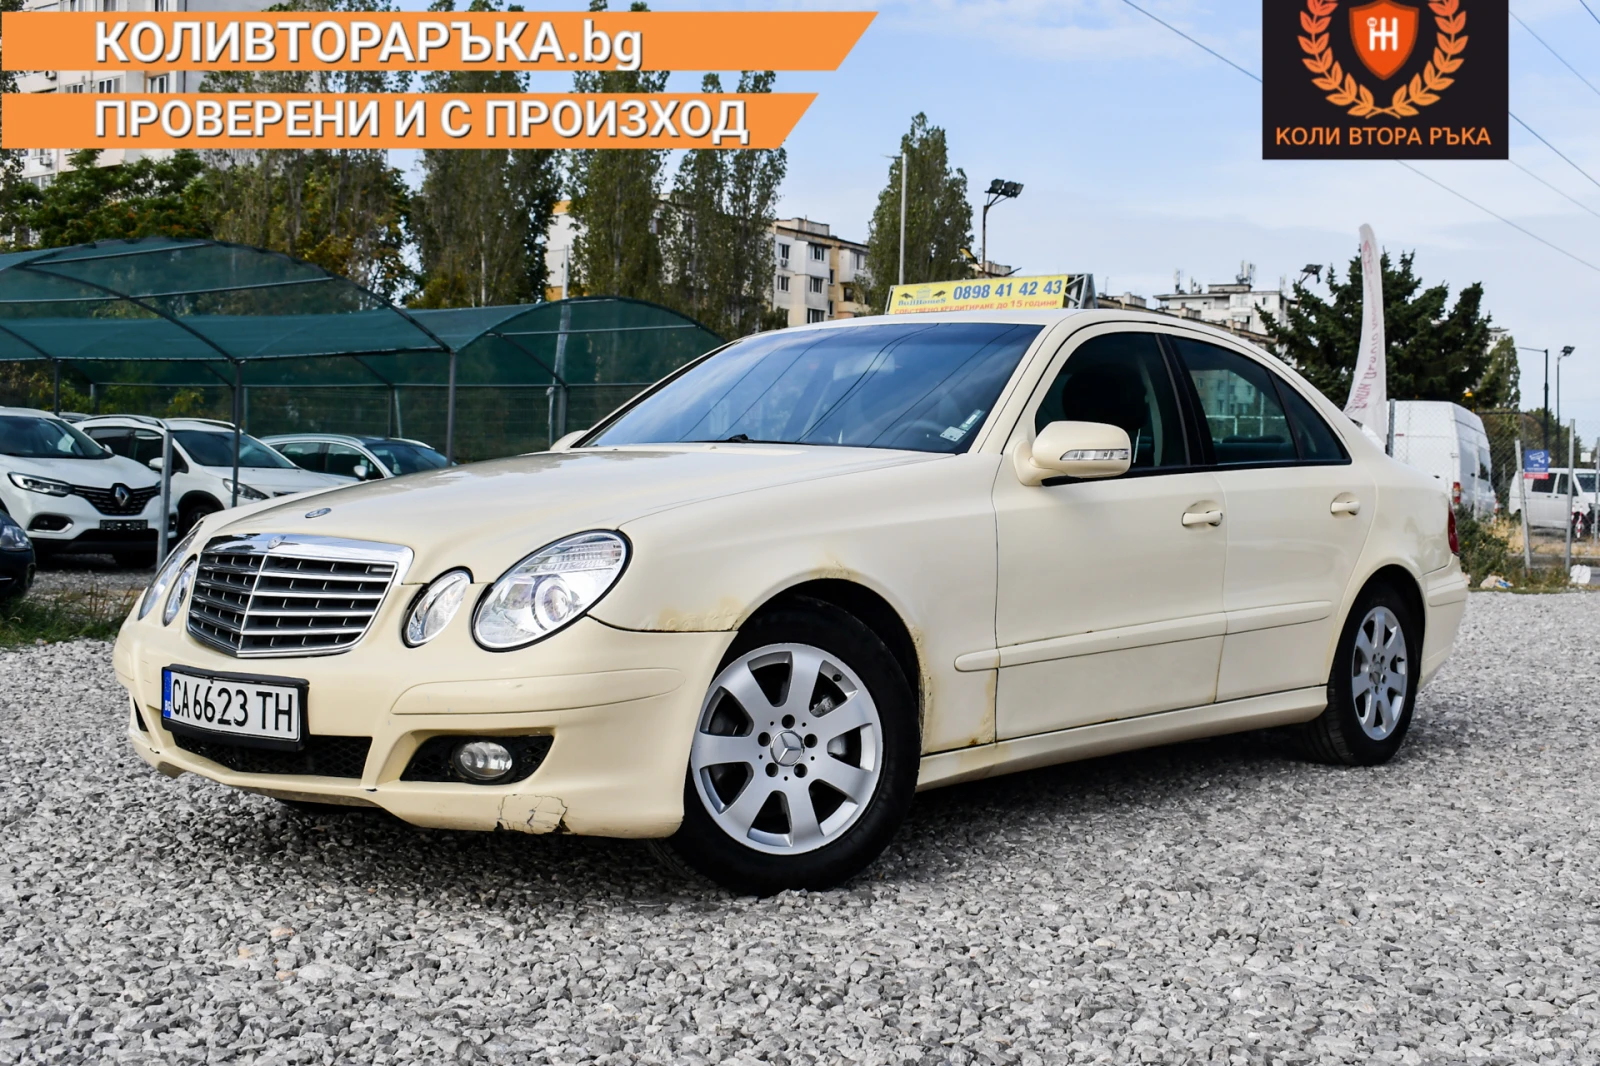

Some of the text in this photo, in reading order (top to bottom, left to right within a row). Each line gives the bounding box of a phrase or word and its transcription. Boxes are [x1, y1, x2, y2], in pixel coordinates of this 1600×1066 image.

[953, 280, 1062, 300] 0898 41 42 43
[1011, 300, 1023, 308] 15
[256, 691, 293, 732] TH
